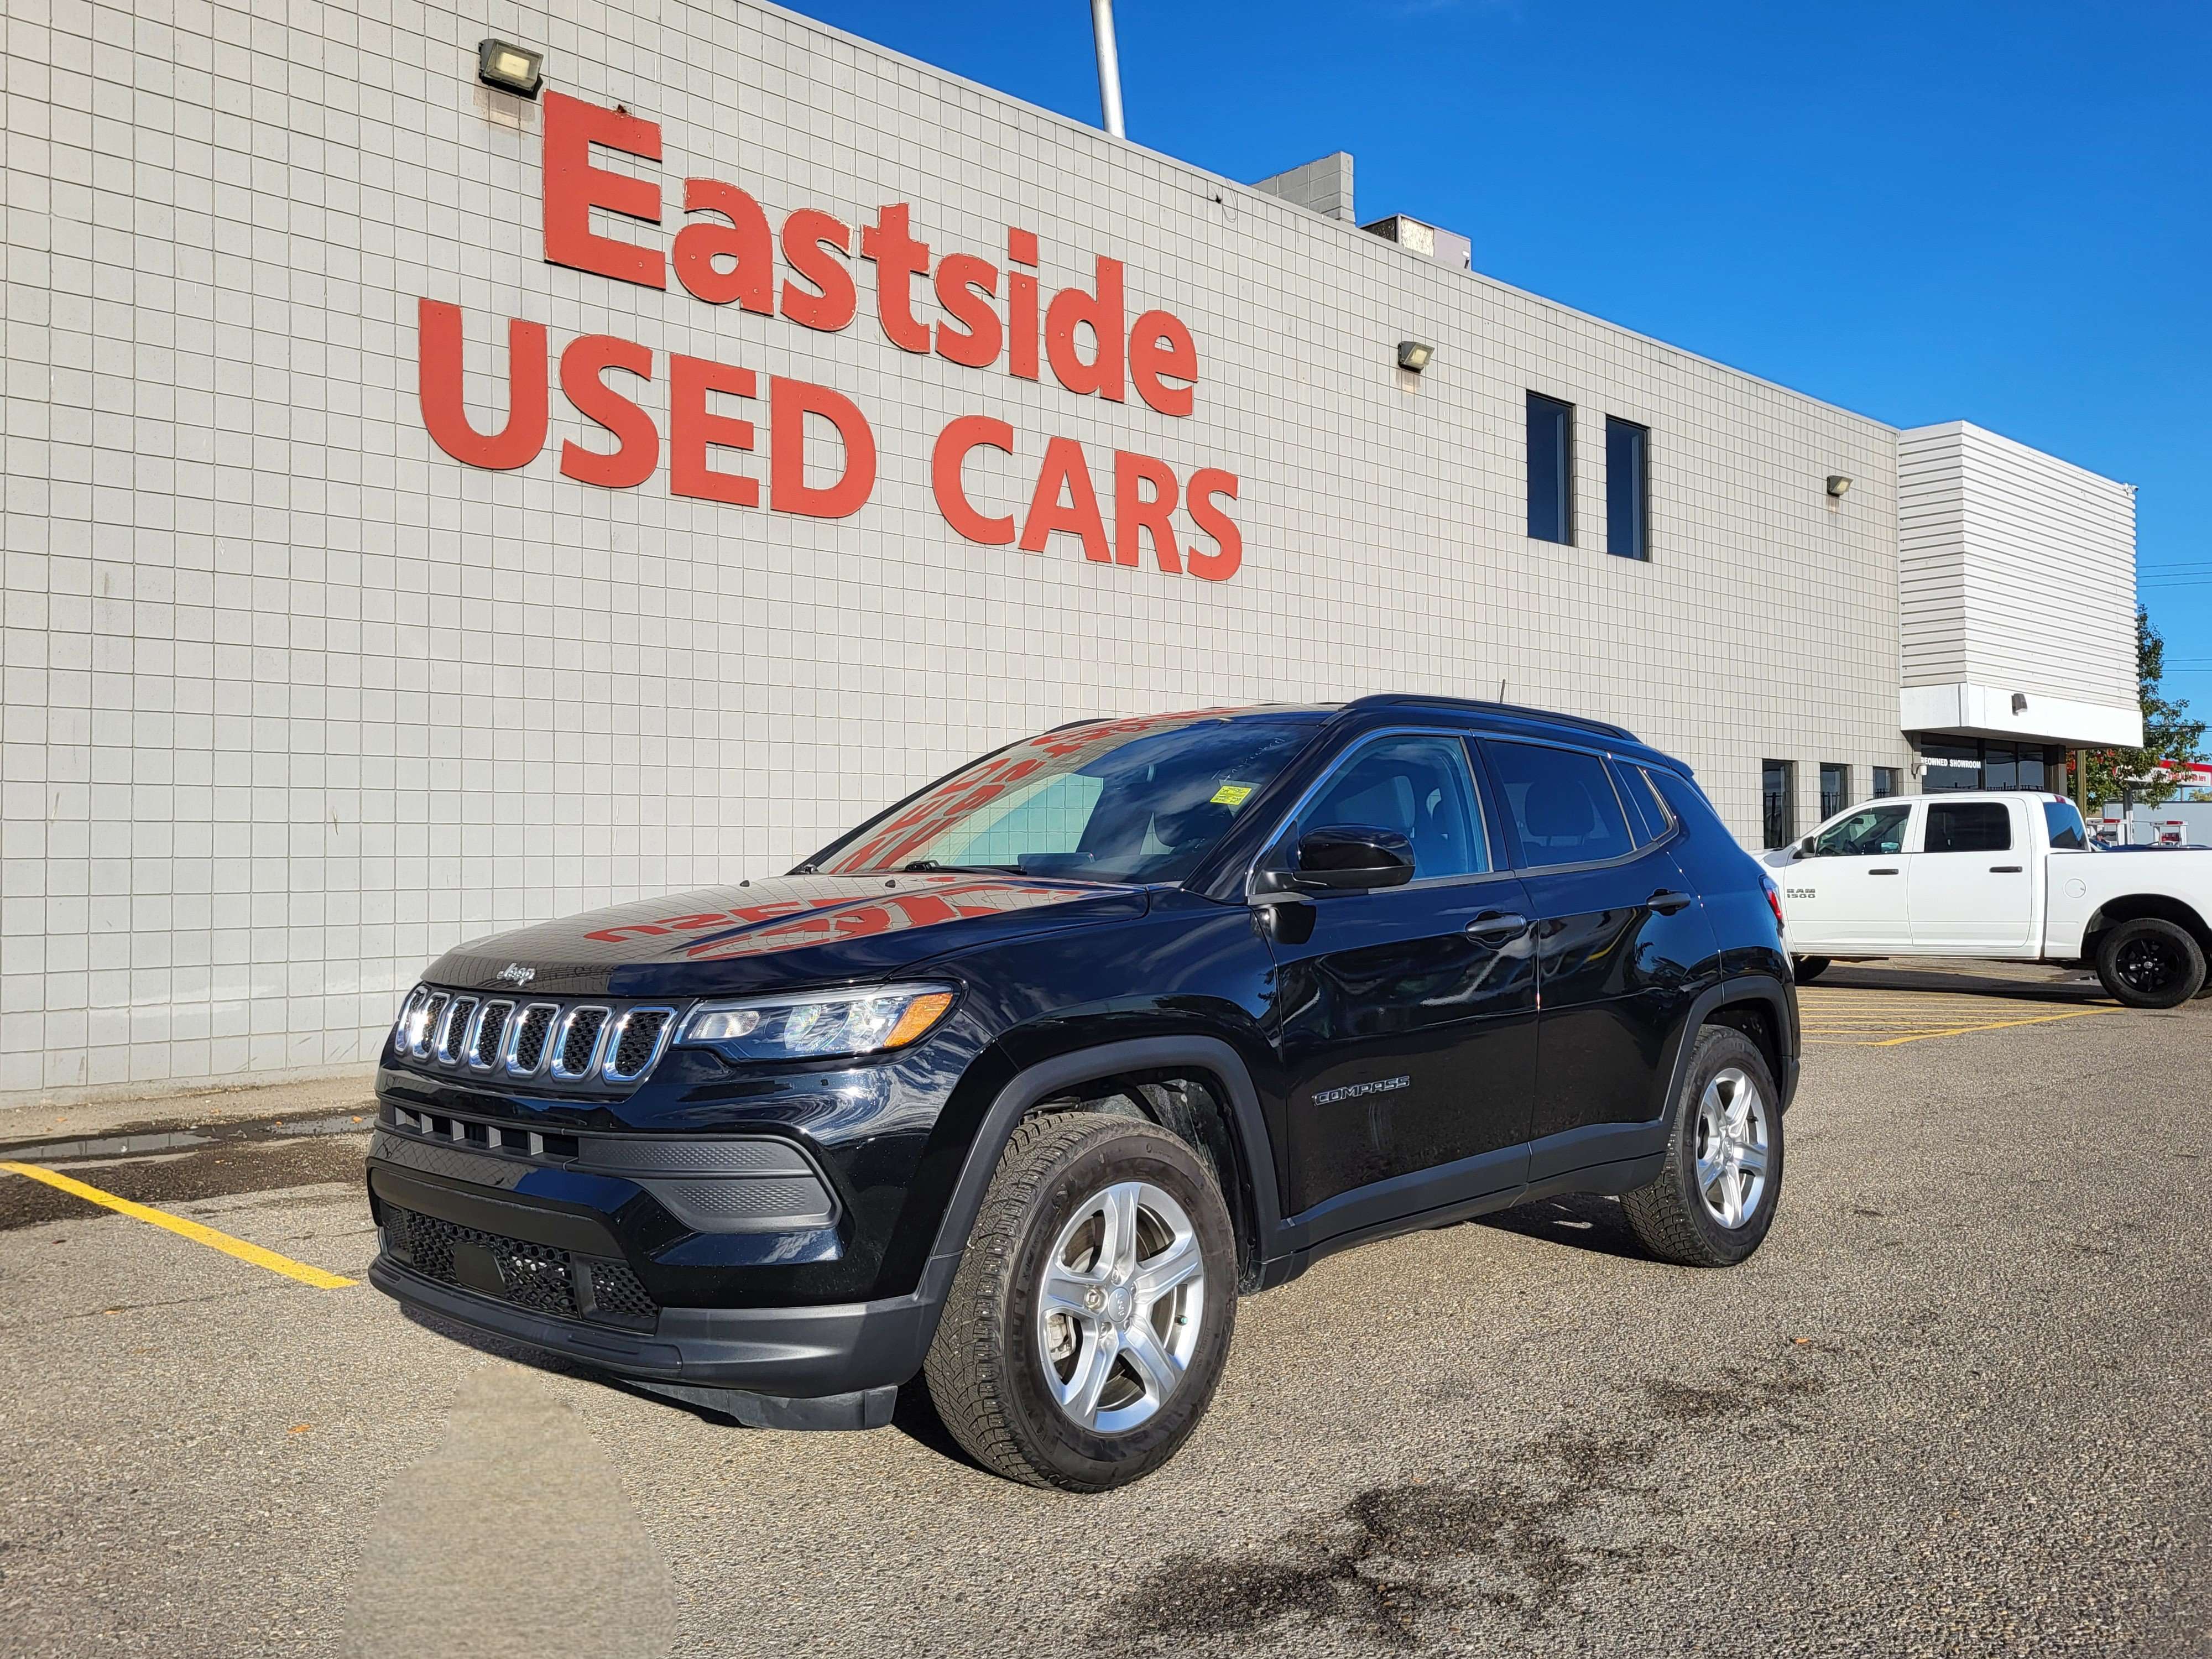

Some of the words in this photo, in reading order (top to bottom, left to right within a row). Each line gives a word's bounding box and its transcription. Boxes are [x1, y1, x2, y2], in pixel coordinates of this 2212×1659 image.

[542, 88, 1198, 417] Eastside
[419, 296, 877, 519] USED
[932, 415, 1243, 581] CARS
[1949, 759, 1981, 769] SHOWROOM
[496, 962, 536, 987] Jeep
[1312, 1075, 1411, 1106] COMPASS
